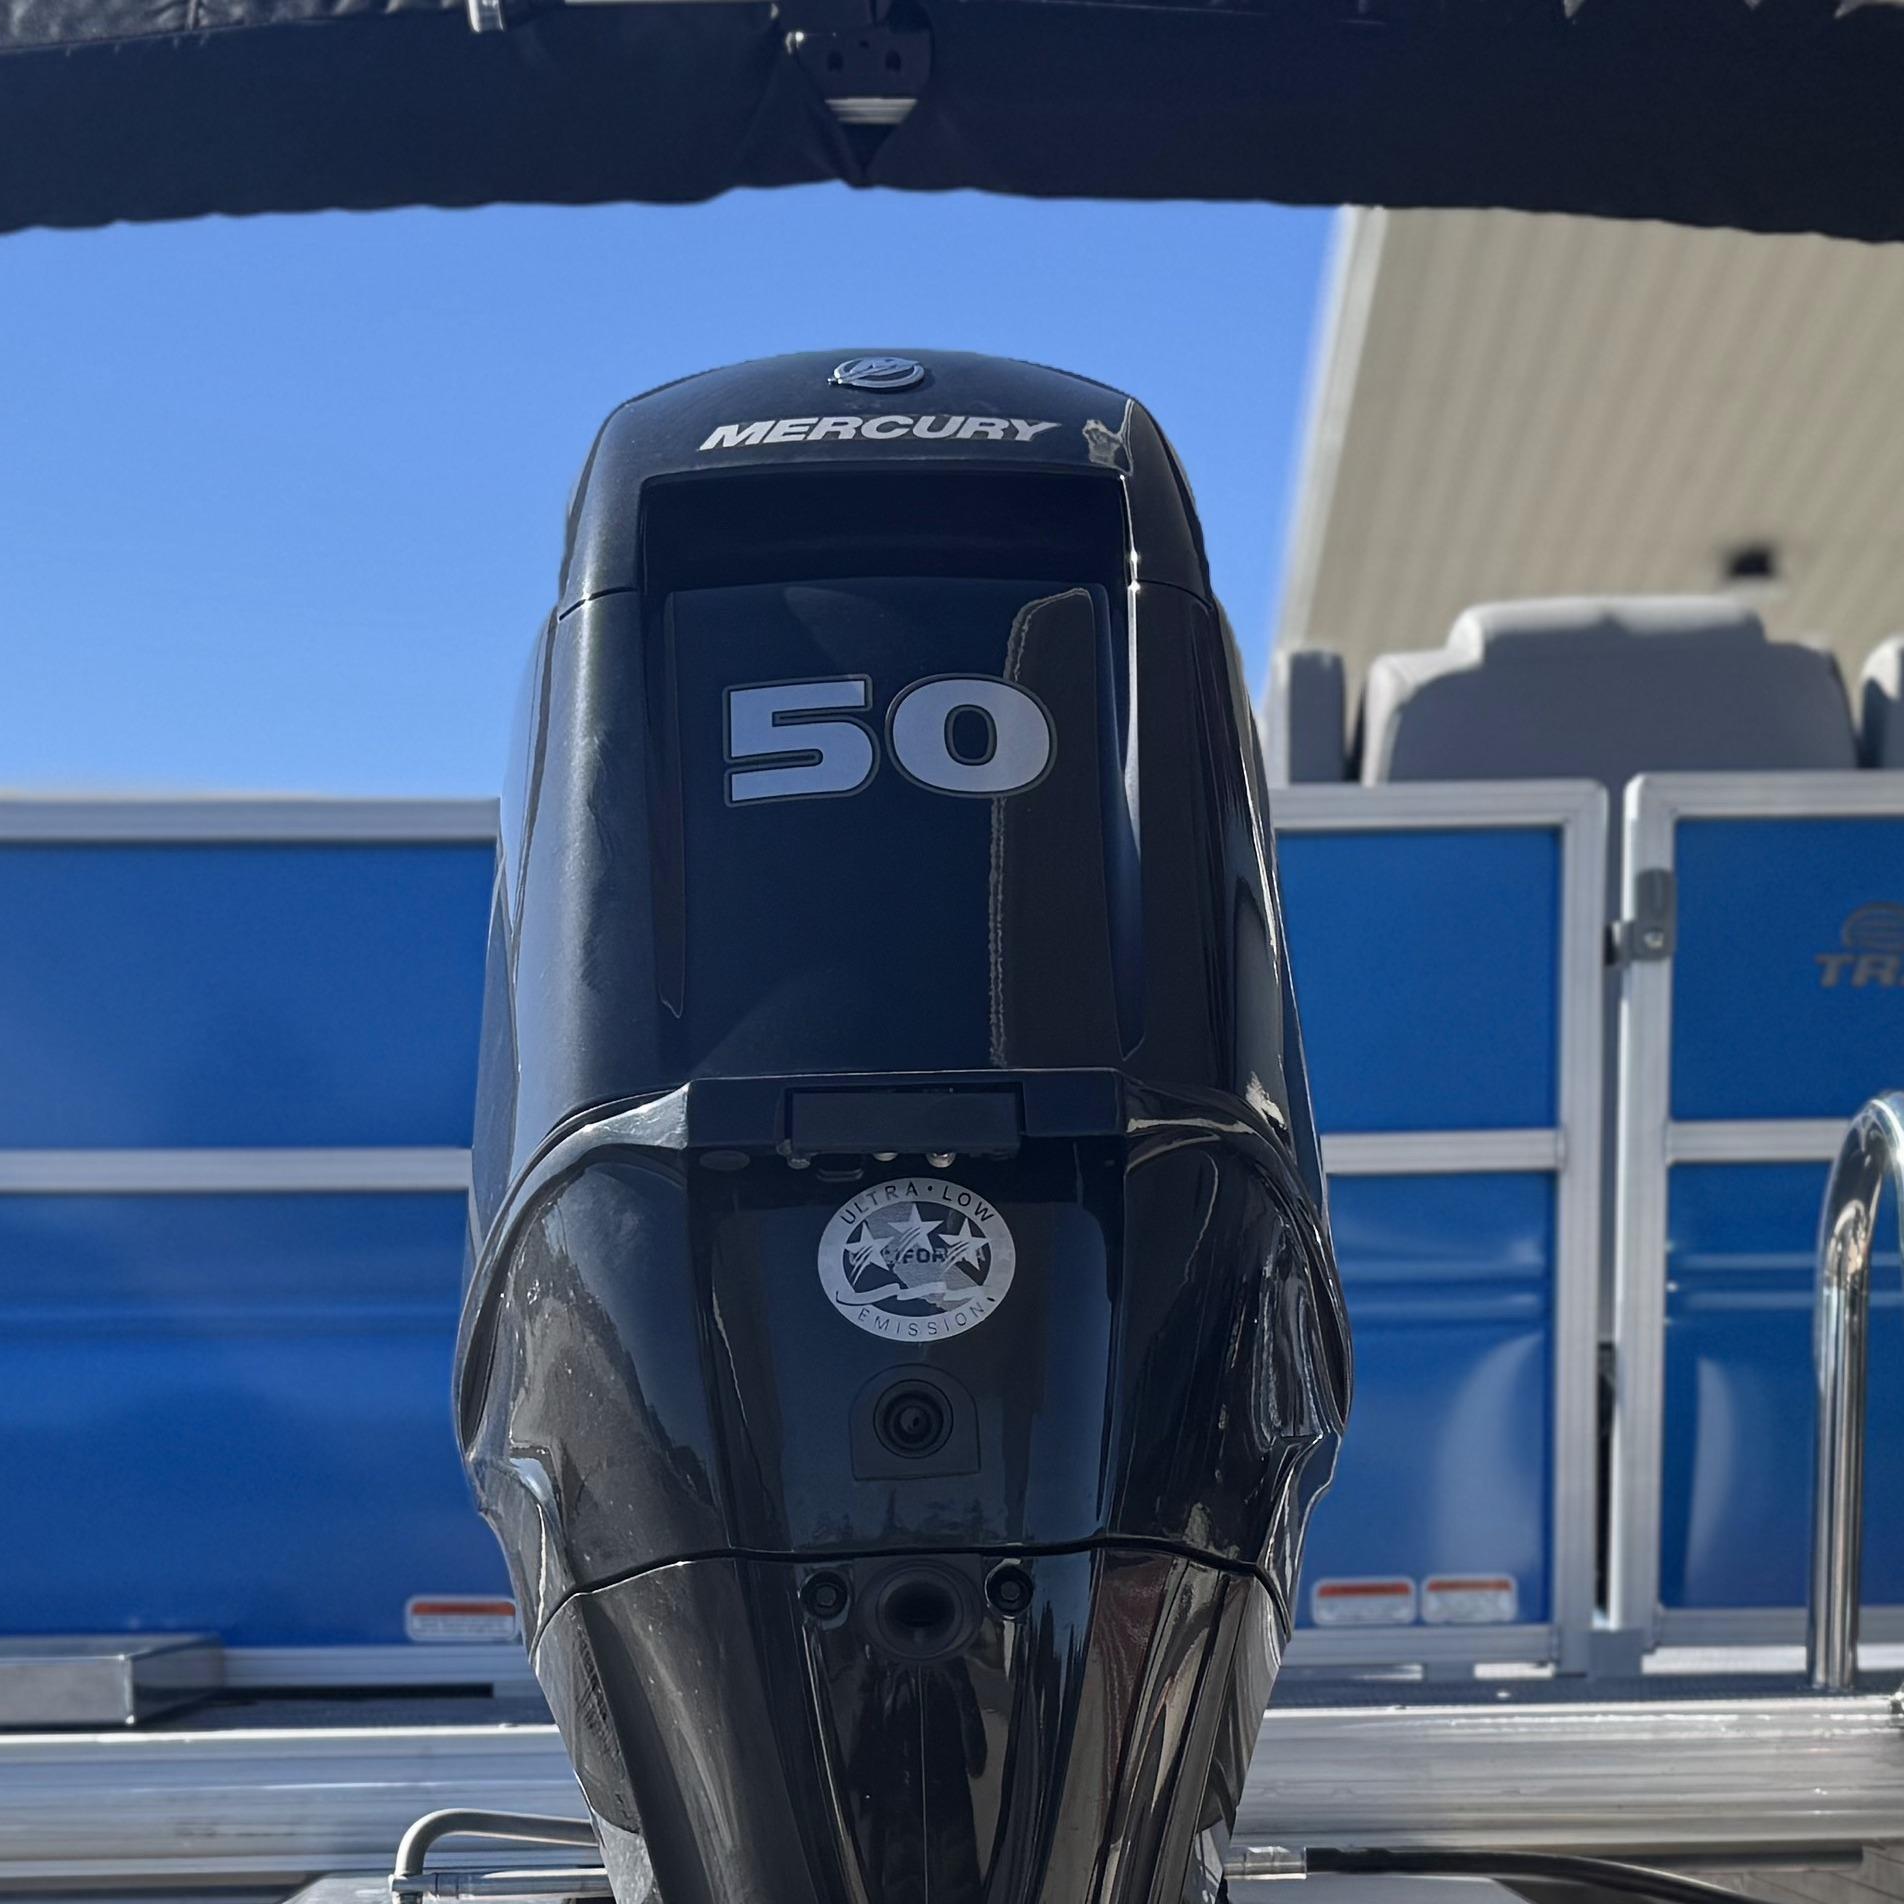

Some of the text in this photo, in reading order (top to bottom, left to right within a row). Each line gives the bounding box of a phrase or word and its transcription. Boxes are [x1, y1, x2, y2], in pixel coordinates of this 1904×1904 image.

[698, 414, 1063, 452] MERCURY
[722, 672, 1057, 808] 50
[840, 1181, 995, 1226] ULTRA LOW
[857, 1301, 985, 1337] EMISSION
